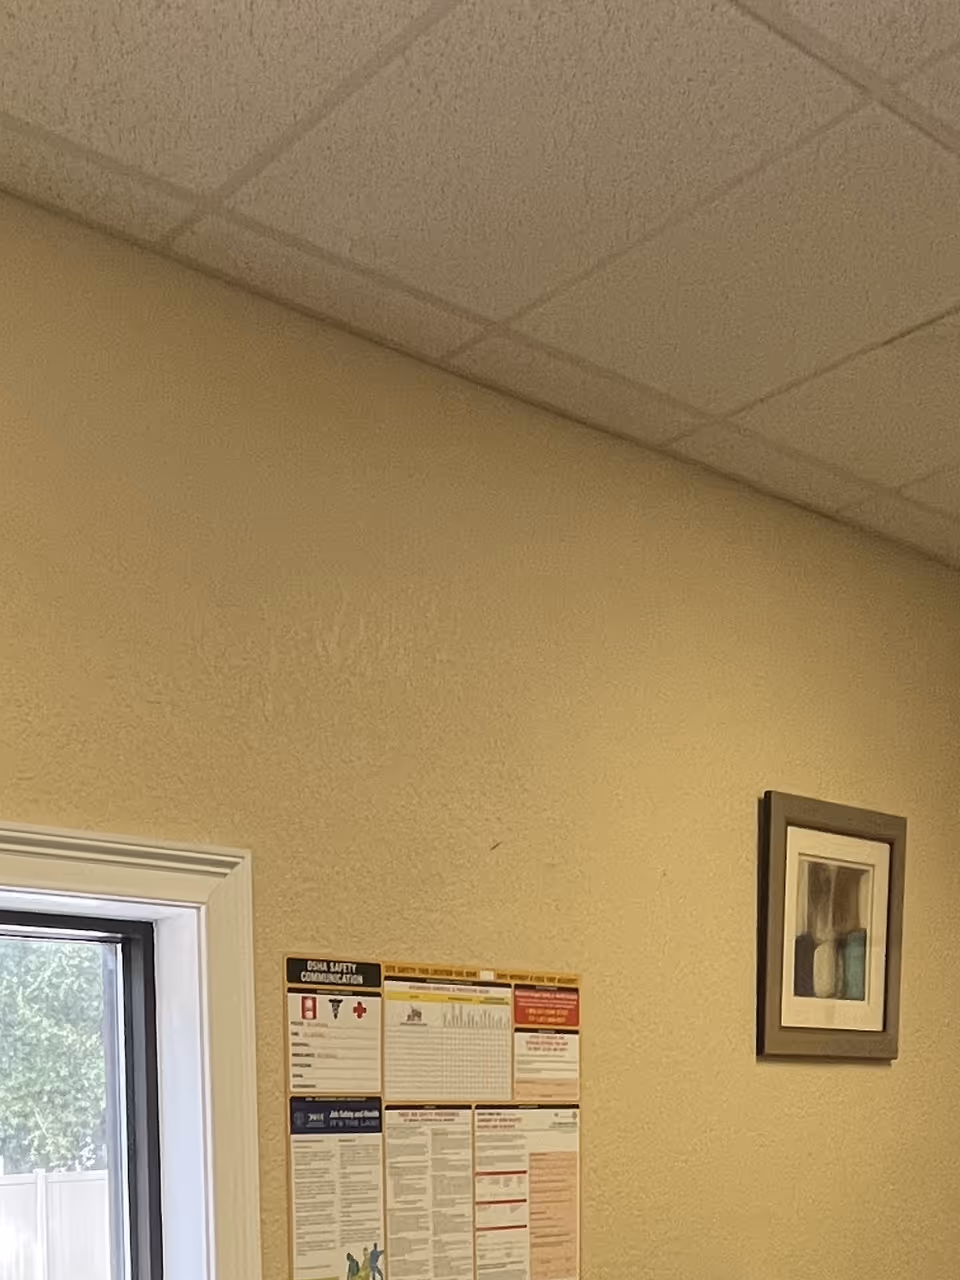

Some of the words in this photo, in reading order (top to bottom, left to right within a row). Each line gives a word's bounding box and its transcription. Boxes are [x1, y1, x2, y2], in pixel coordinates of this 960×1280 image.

[307, 960, 328, 972] OSHA
[329, 962, 357, 973] SAFETY
[300, 971, 363, 984] COMMUNICATION
